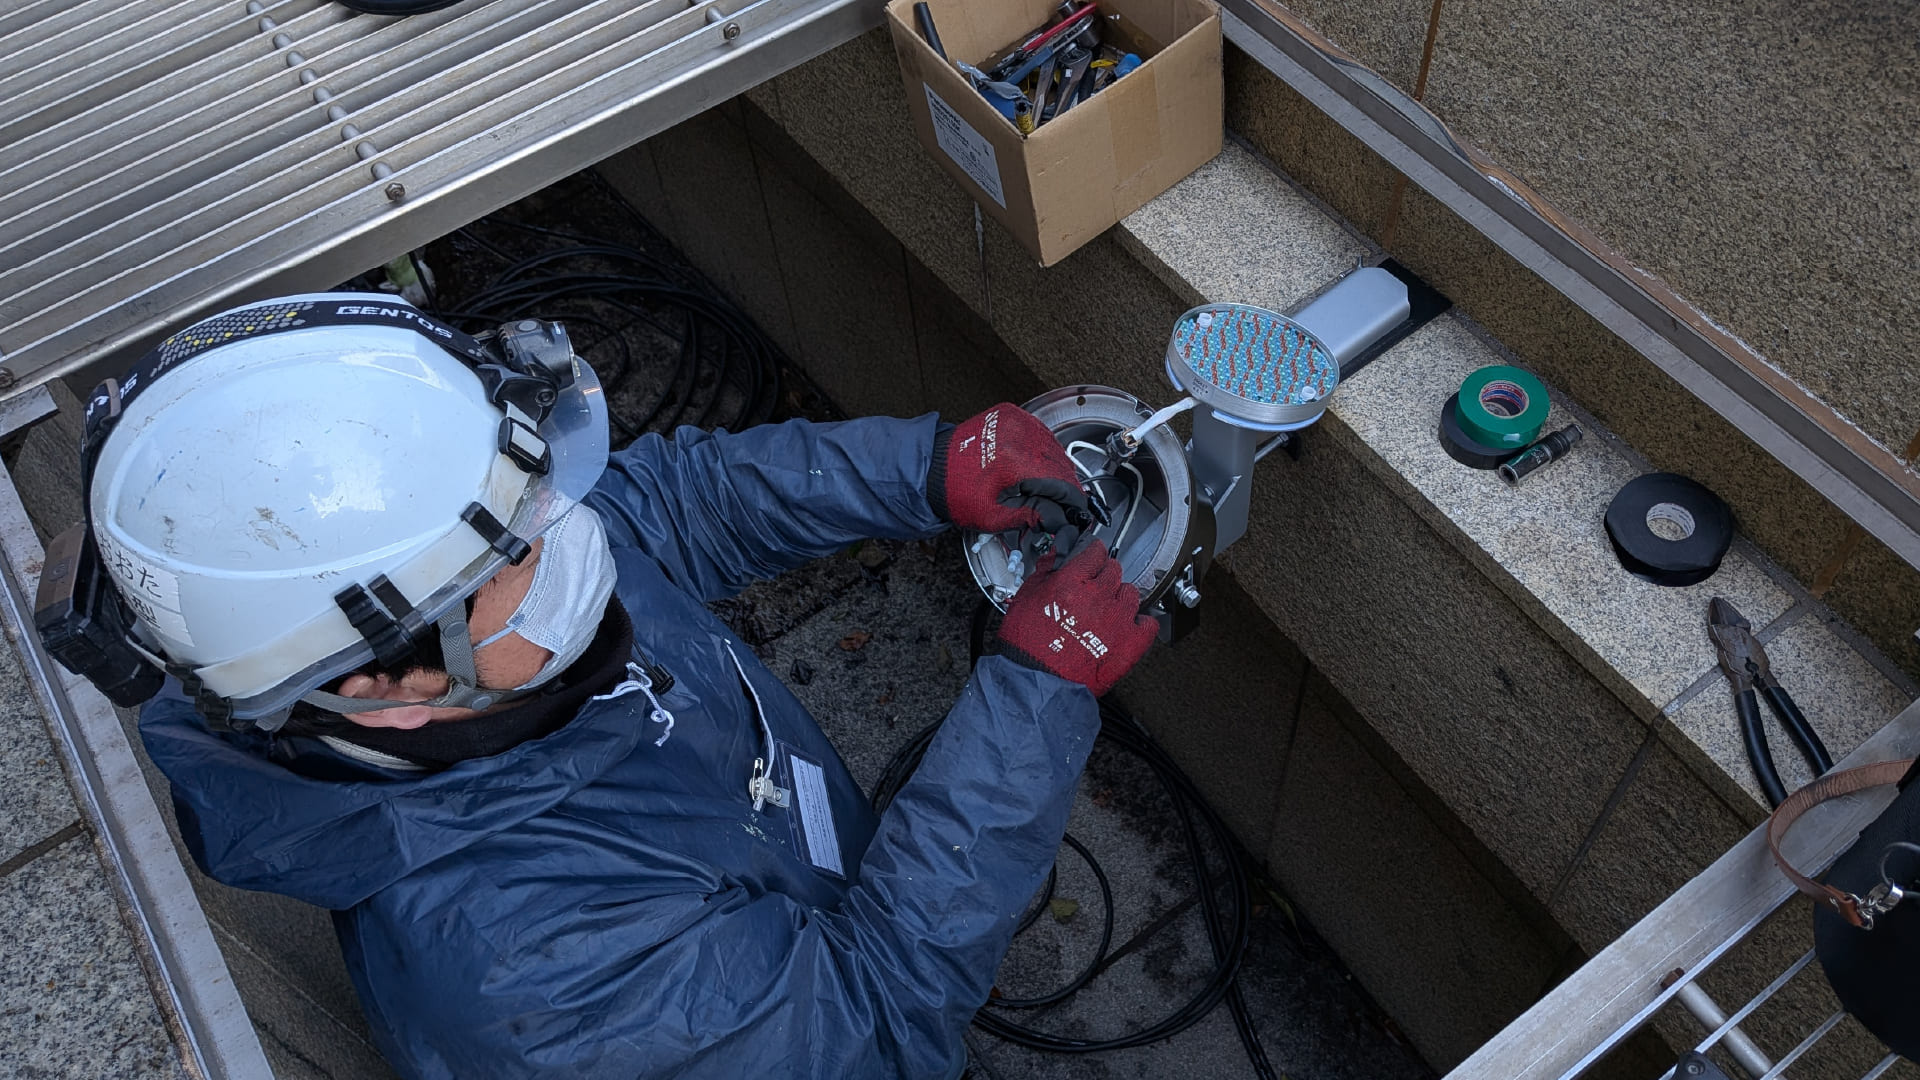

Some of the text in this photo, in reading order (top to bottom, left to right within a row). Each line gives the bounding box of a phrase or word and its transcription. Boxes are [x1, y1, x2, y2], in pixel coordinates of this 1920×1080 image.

[336, 305, 453, 339] GENTOS
[99, 530, 163, 599] おおた
[1065, 615, 1108, 656] SPER
